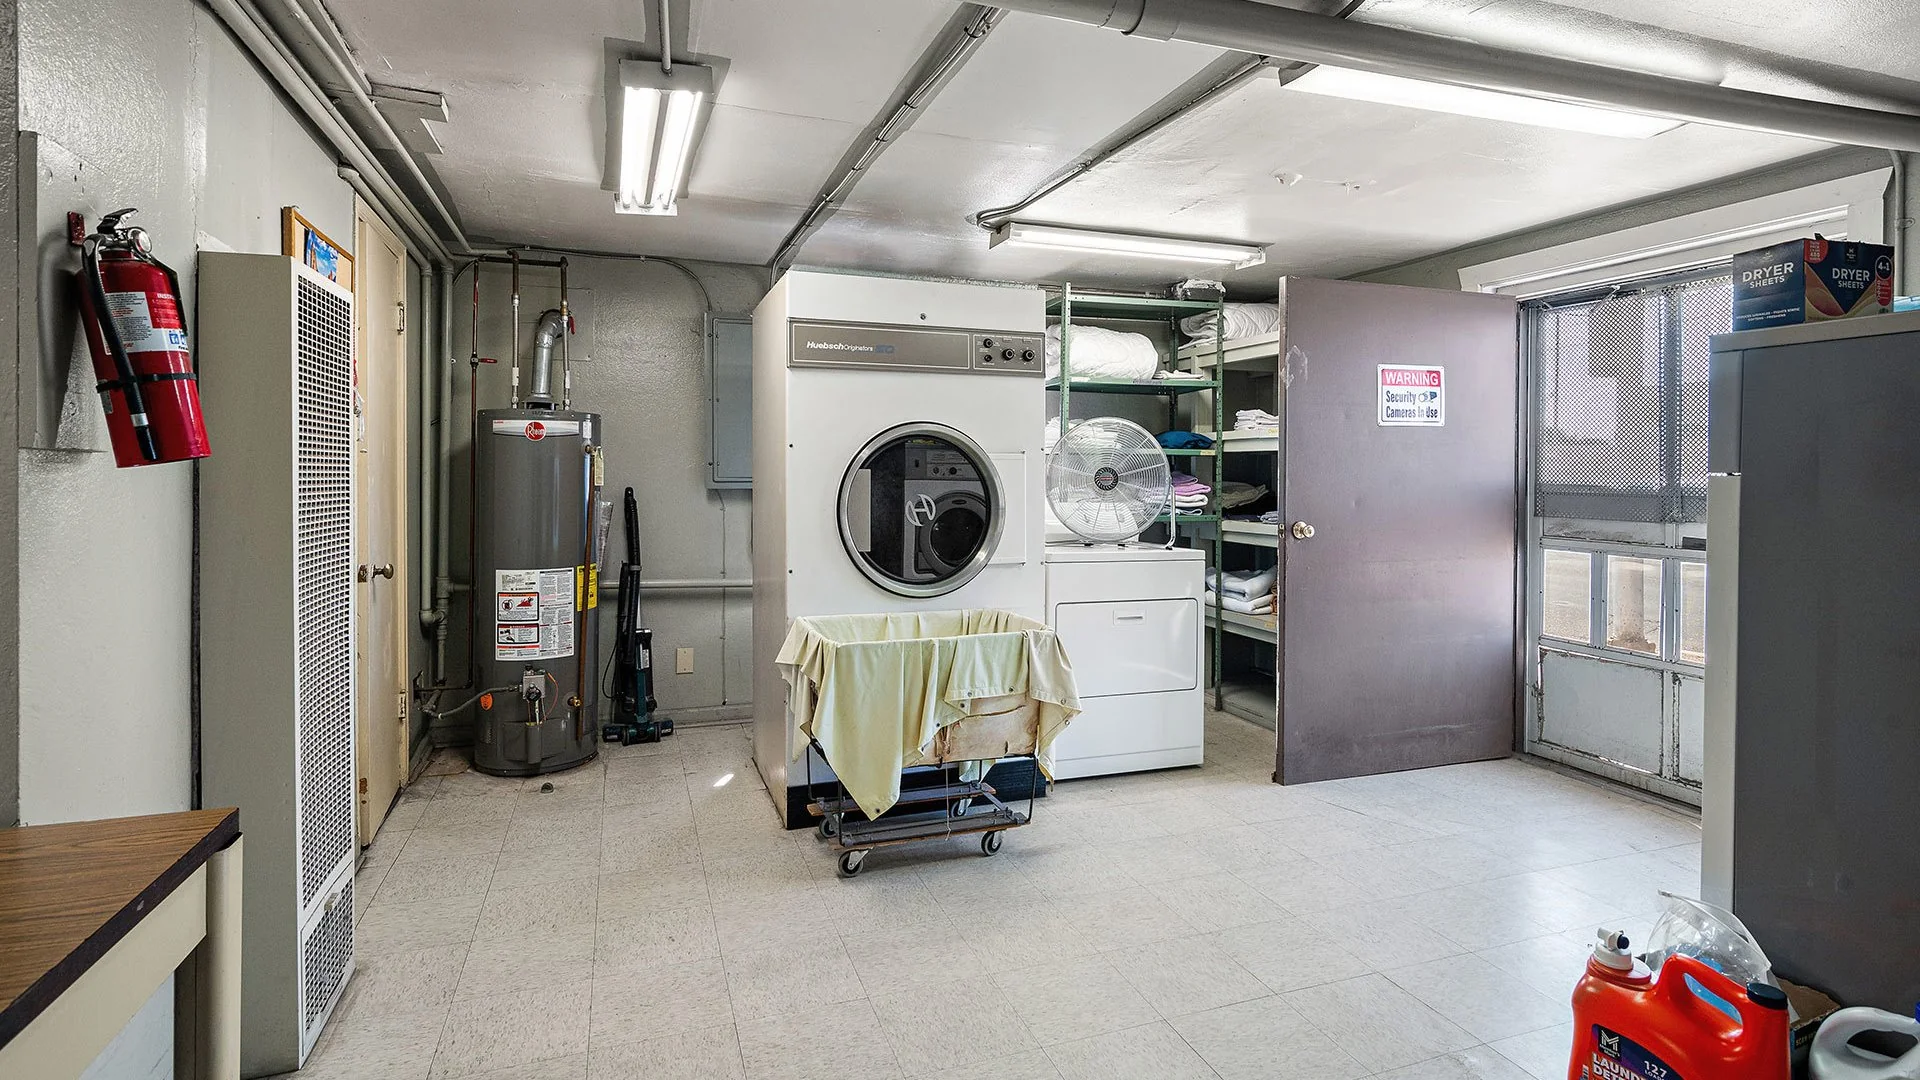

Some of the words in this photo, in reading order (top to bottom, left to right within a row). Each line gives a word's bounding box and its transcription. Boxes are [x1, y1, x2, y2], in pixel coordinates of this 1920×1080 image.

[1742, 262, 1794, 282] DRYER
[1832, 267, 1870, 282] DRYER
[1749, 275, 1785, 289] SHEETS
[1837, 280, 1865, 290] SHEETS
[1385, 371, 1439, 386] WARNING
[1386, 390, 1417, 406] Security
[1386, 406, 1417, 418] Cameras
[1418, 406, 1425, 418] In
[1426, 406, 1438, 418] Use
[1644, 1060, 1667, 1078] 127
